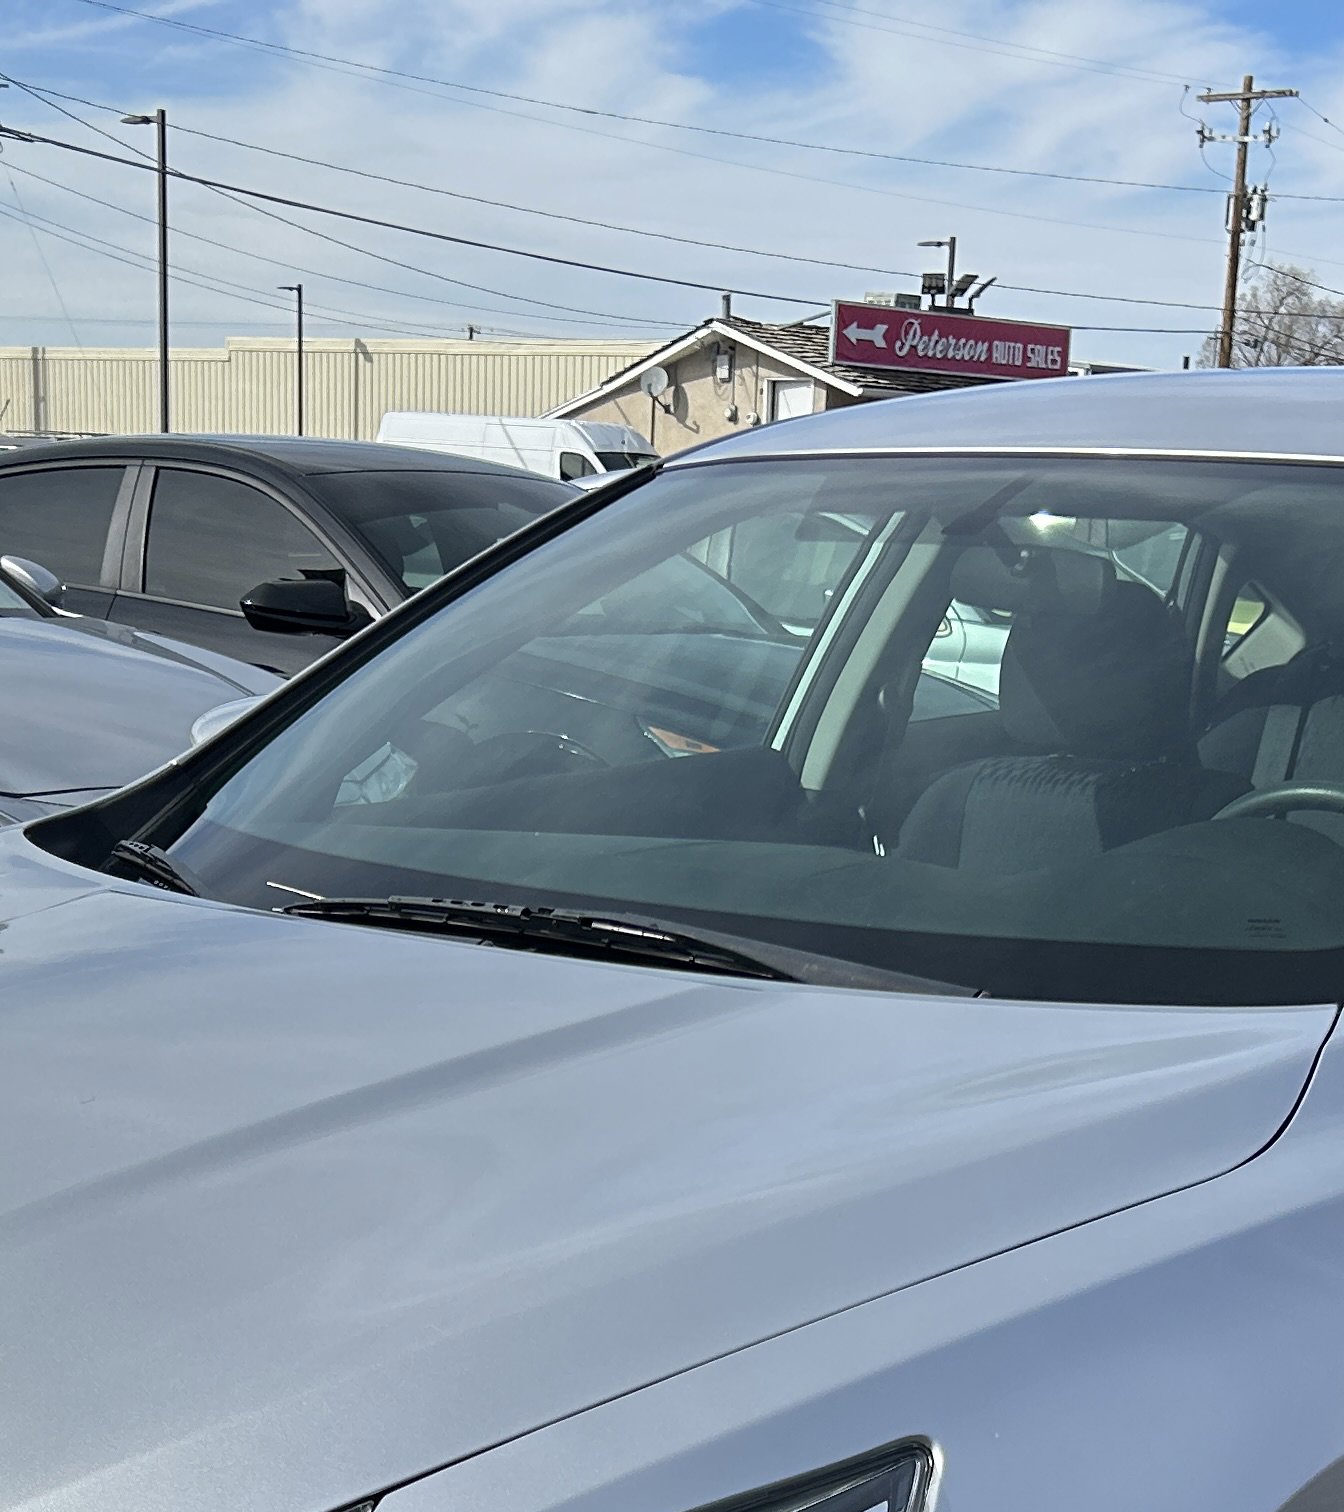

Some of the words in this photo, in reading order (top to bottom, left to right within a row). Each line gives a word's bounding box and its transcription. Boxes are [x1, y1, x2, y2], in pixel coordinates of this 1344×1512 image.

[895, 318, 989, 362] Peterson
[992, 340, 1023, 367] AUTO
[1026, 344, 1062, 370] SALES
